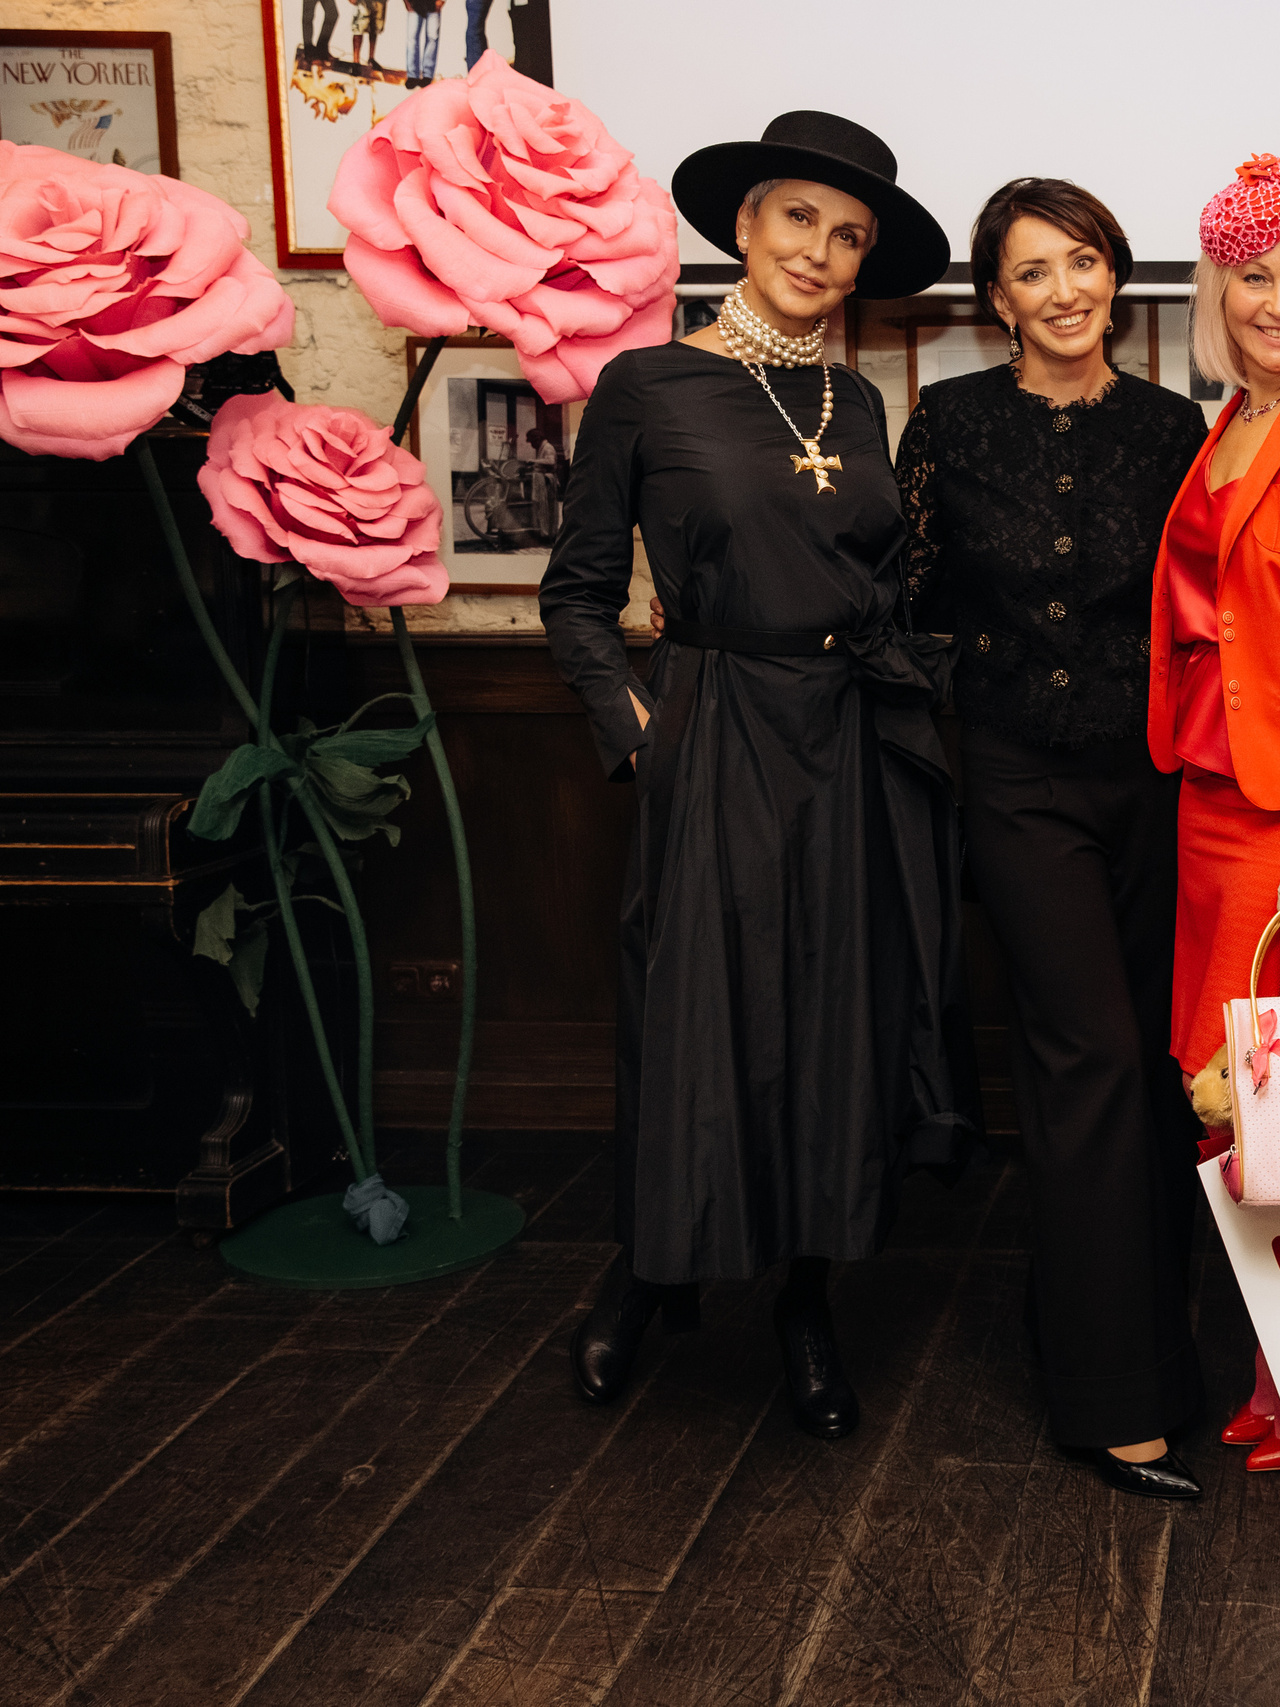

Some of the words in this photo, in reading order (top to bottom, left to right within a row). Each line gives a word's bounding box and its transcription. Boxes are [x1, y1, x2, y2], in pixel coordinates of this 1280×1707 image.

[59, 48, 84, 60] THE
[3, 62, 56, 85] NEW
[61, 61, 151, 86] YORKER
